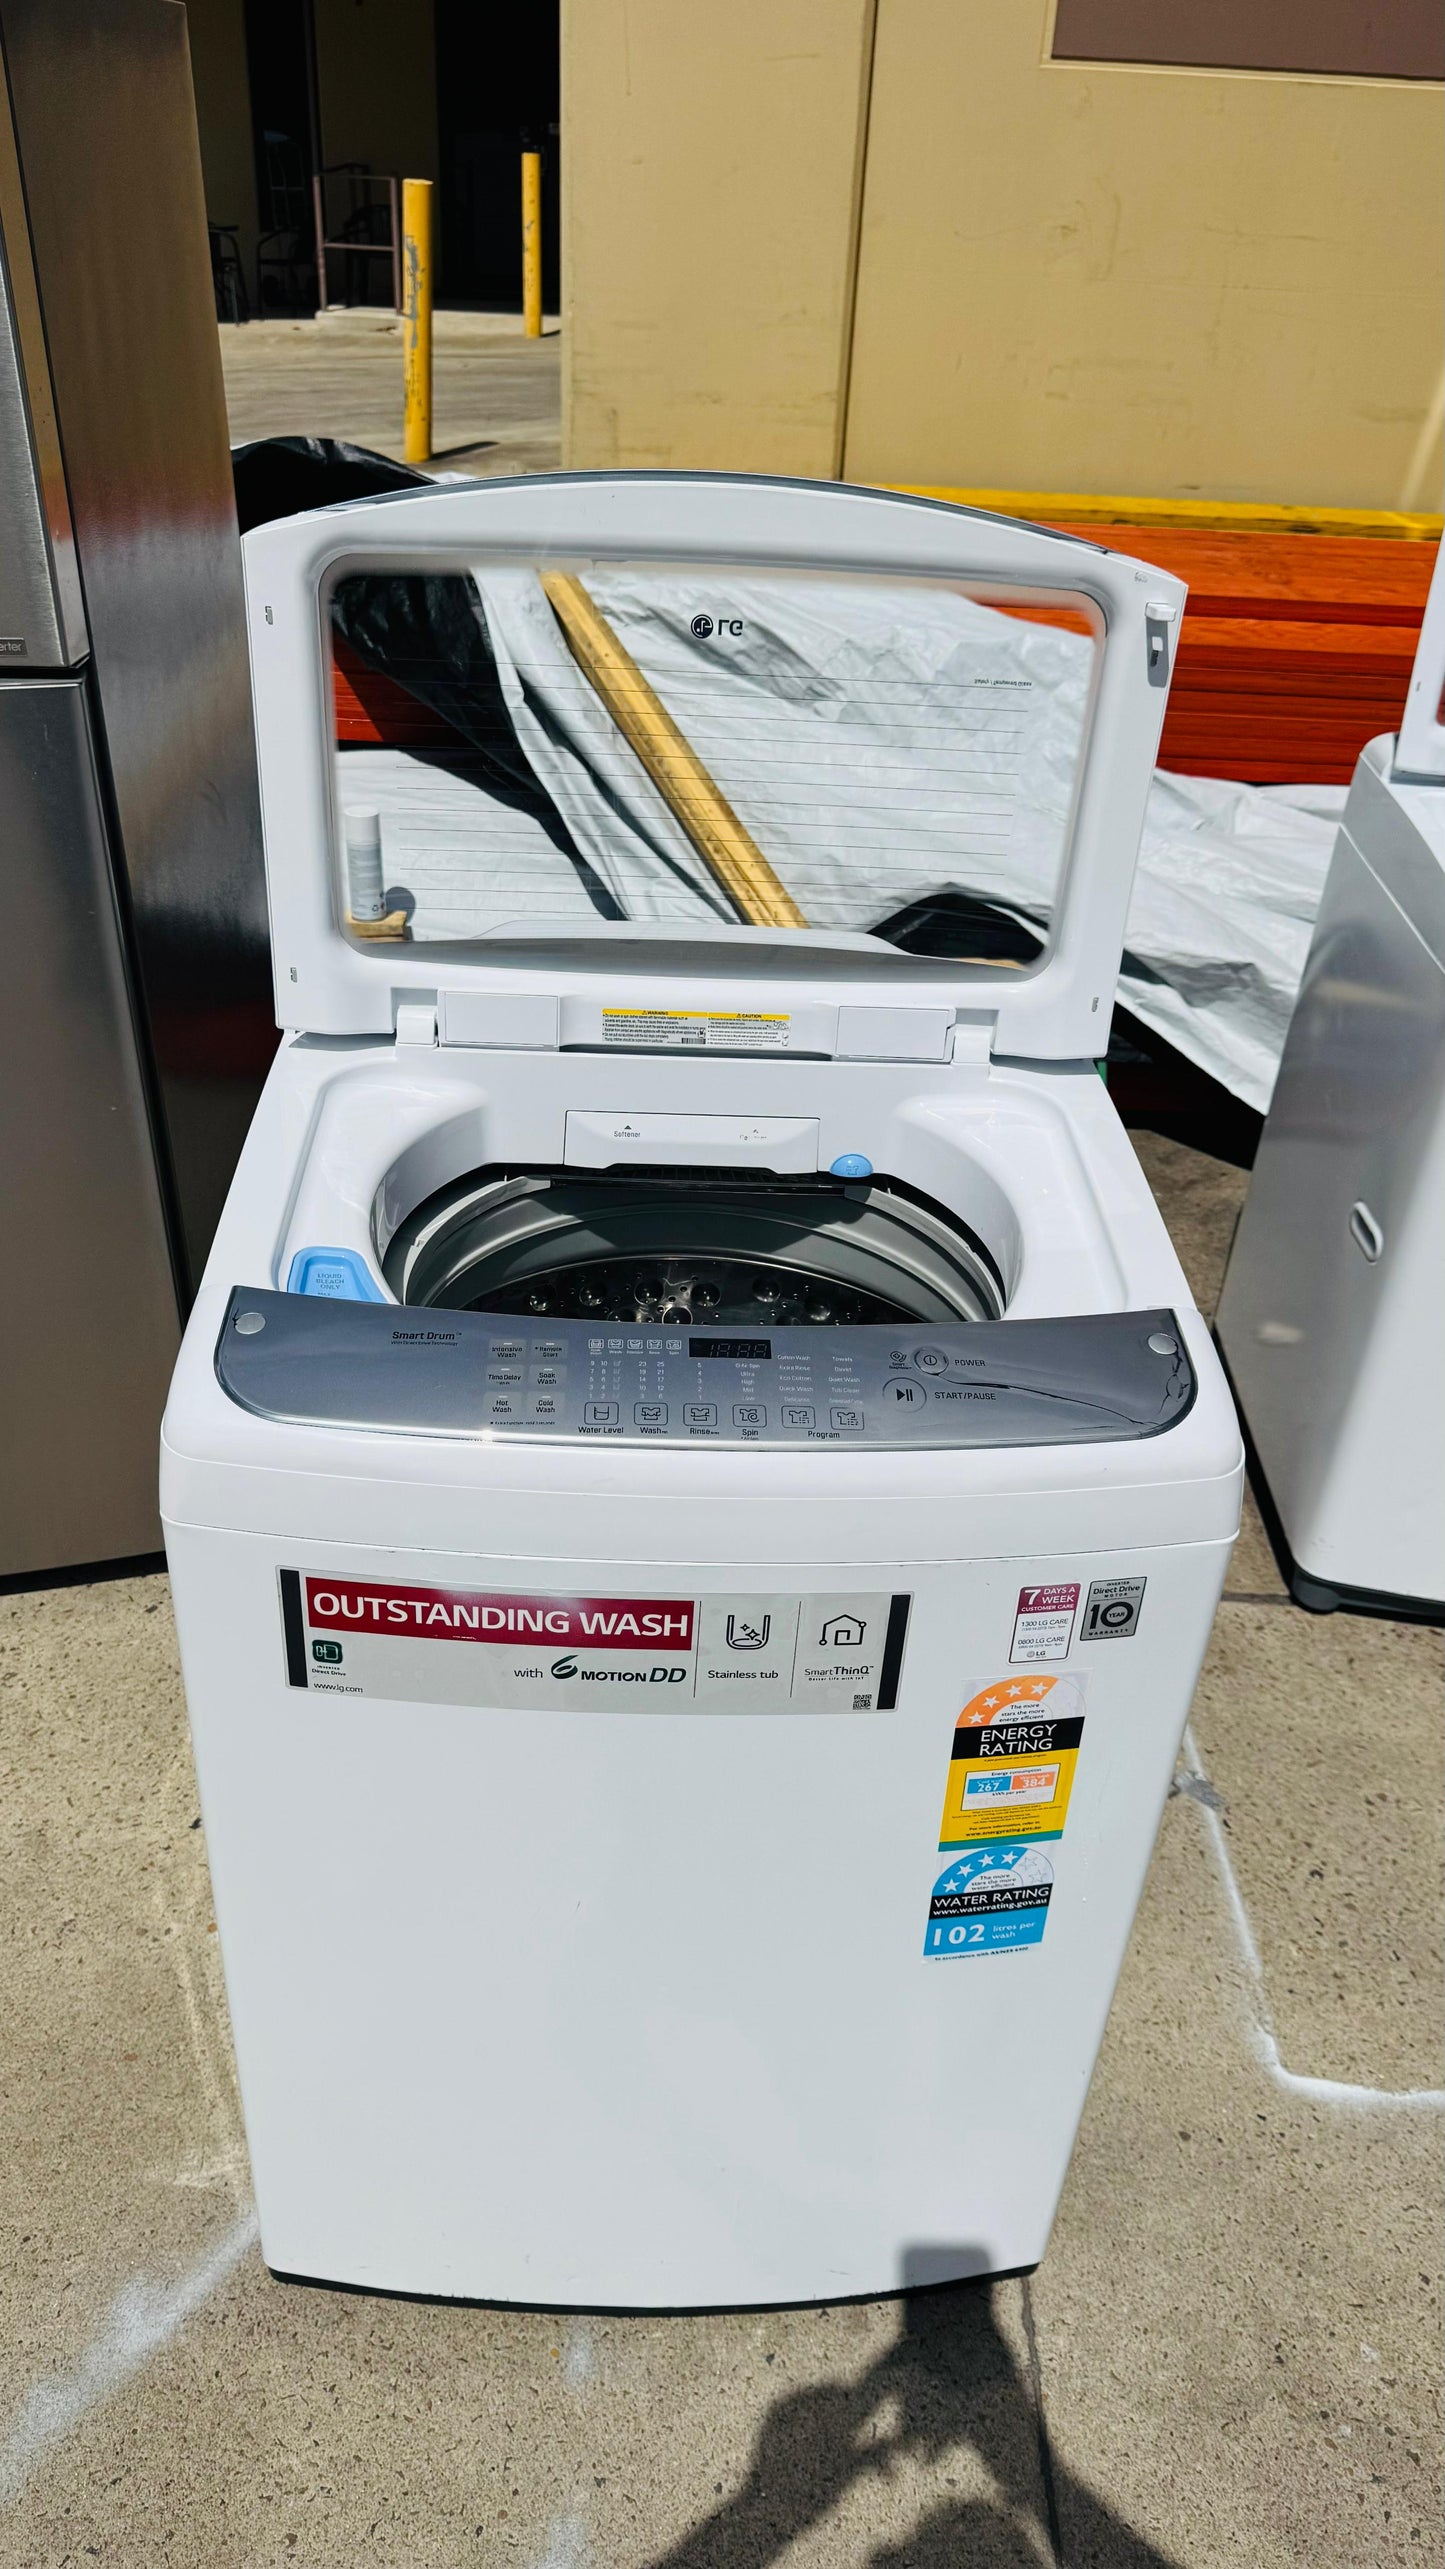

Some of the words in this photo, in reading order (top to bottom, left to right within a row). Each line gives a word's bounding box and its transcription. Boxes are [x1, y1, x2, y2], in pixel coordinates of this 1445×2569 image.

[613, 1130, 641, 1138] Softener
[392, 1331, 424, 1340] Smart
[954, 1359, 986, 1367] POWER
[503, 1374, 522, 1382] Delay
[934, 1391, 997, 1401] START/PAUSE
[742, 1429, 759, 1437] Spin
[808, 1430, 840, 1440] Program
[1043, 1587, 1067, 1595] DAYS
[1093, 1587, 1118, 1595] Direct
[1024, 1589, 1042, 1605] 7
[1042, 1594, 1075, 1604] WEEK
[313, 1592, 570, 1633] OUTSTANDING
[579, 1612, 688, 1637] WASH
[1089, 1601, 1134, 1630] 10
[1088, 1628, 1129, 1636] WARRANTY
[1017, 1638, 1034, 1646] 0800
[1046, 1635, 1066, 1643] CARE
[514, 1667, 544, 1678] with
[707, 1669, 757, 1679] Stainless
[760, 1669, 779, 1679] tub
[313, 1682, 363, 1693] www.lg.com
[980, 1723, 1058, 1743] ENERGY
[979, 1738, 1053, 1756] RATING
[977, 1782, 1000, 1792] 267
[1022, 1777, 1046, 1788] 384
[934, 1895, 988, 1908] WATER
[992, 1887, 1050, 1903] RATING
[932, 1898, 1048, 1916] www.waterrating.gov.au
[992, 1924, 1017, 1933] litres
[1019, 1921, 1036, 1930] per
[933, 1923, 985, 1947] 102
[991, 1931, 1016, 1940] wash
